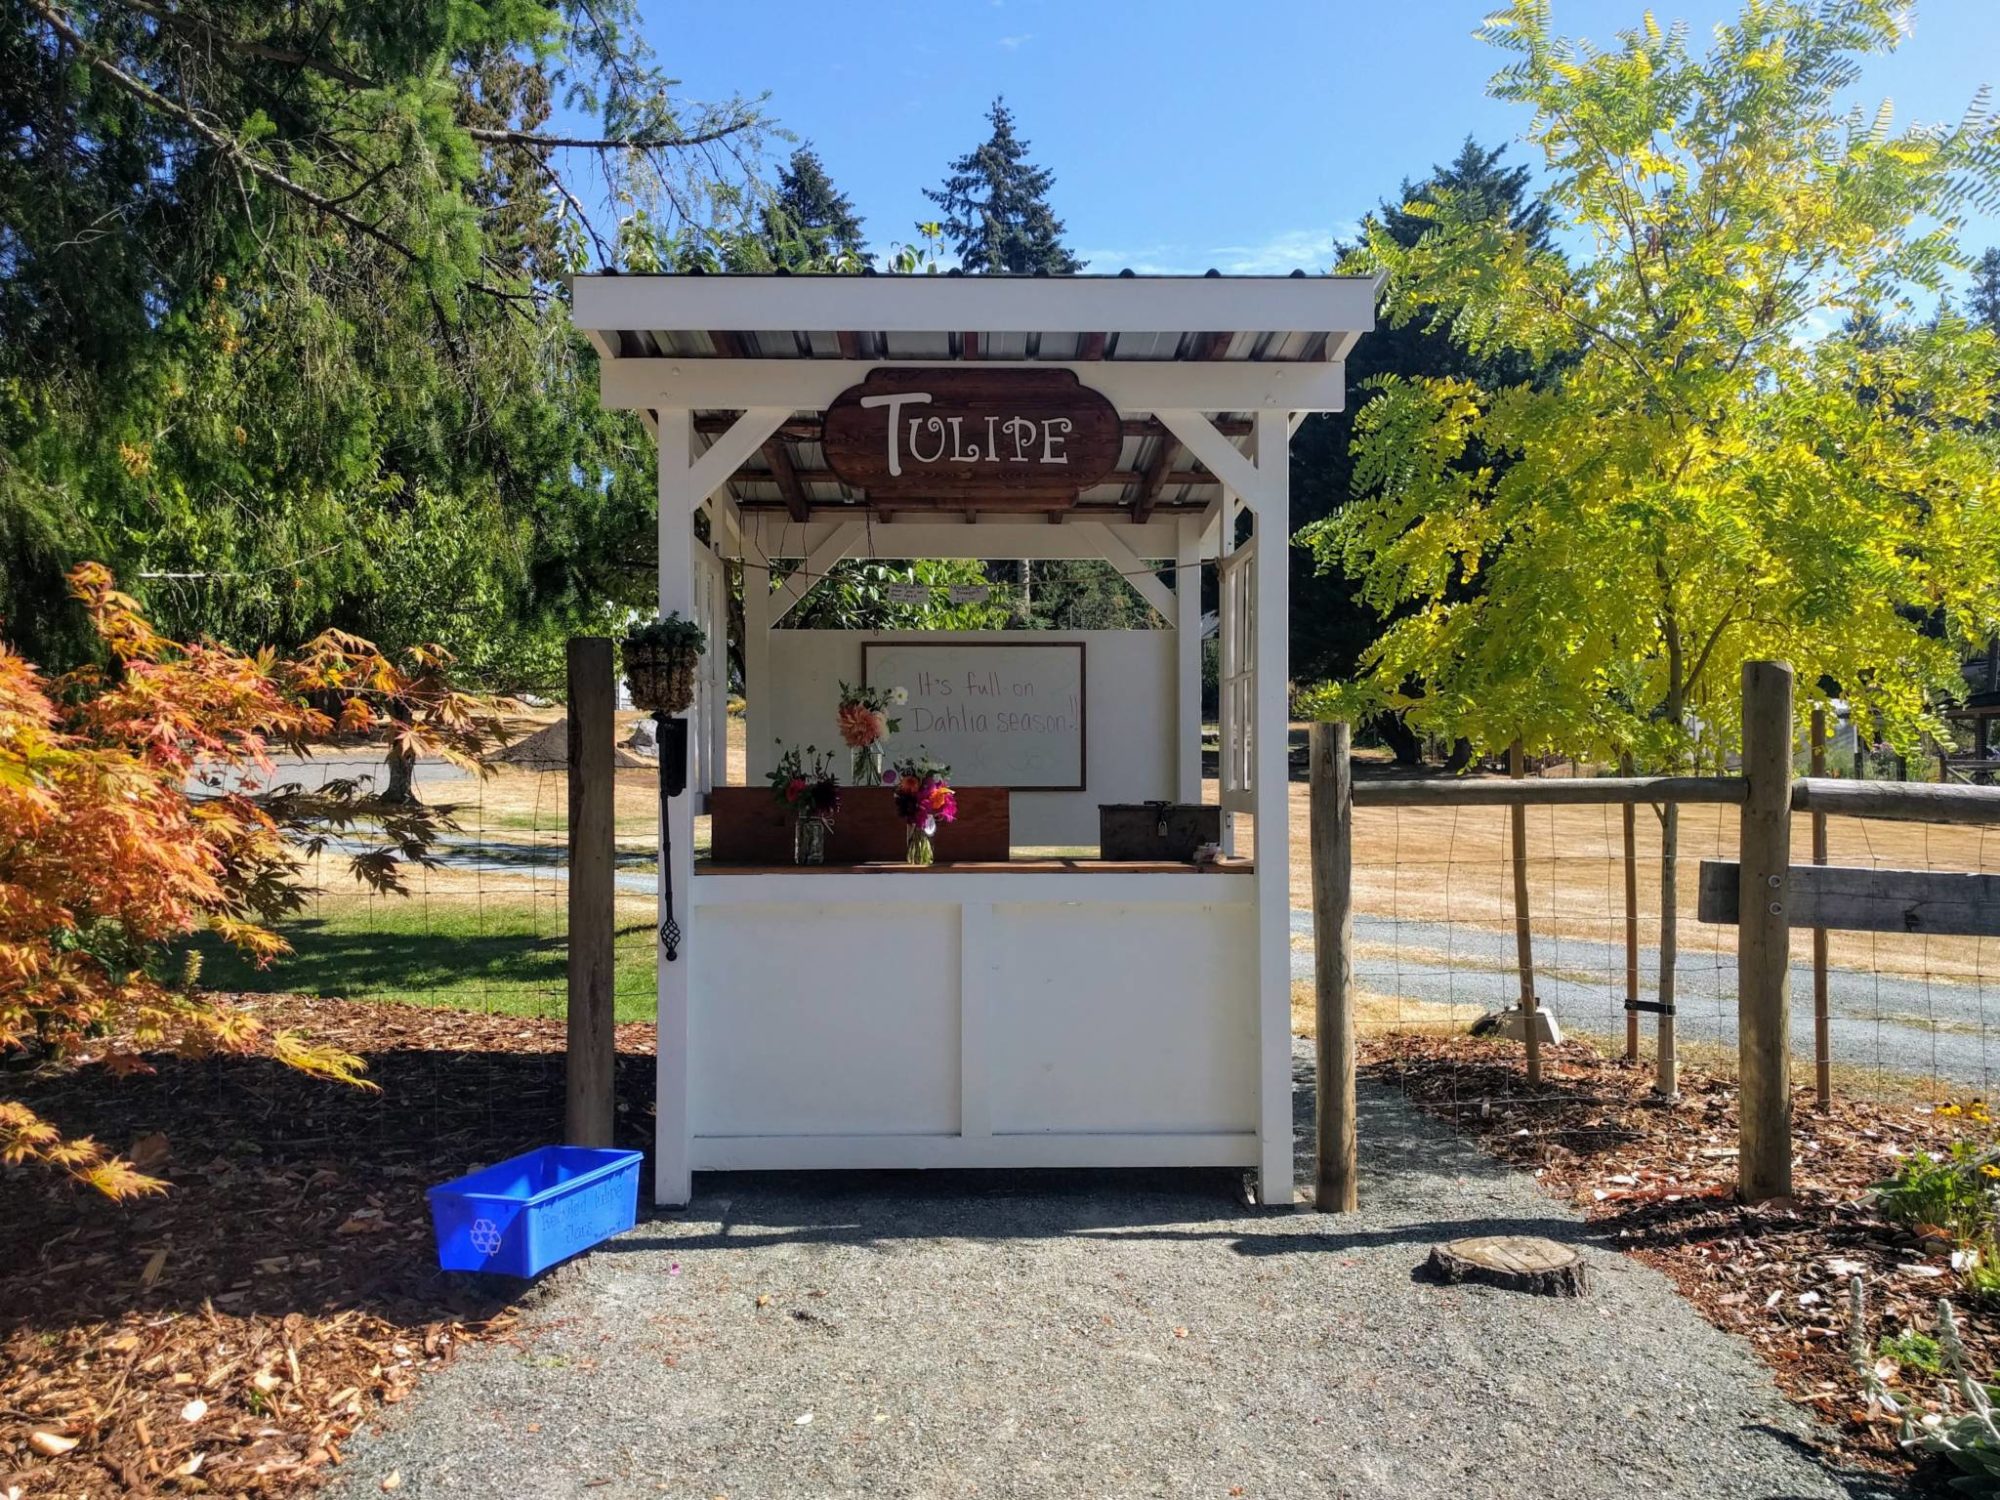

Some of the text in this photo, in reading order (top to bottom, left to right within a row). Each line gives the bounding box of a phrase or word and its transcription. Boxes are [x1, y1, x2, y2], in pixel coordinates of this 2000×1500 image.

[860, 392, 1073, 477] TULIPE
[918, 671, 1034, 698] It's full on
[910, 703, 988, 733] Dahlia
